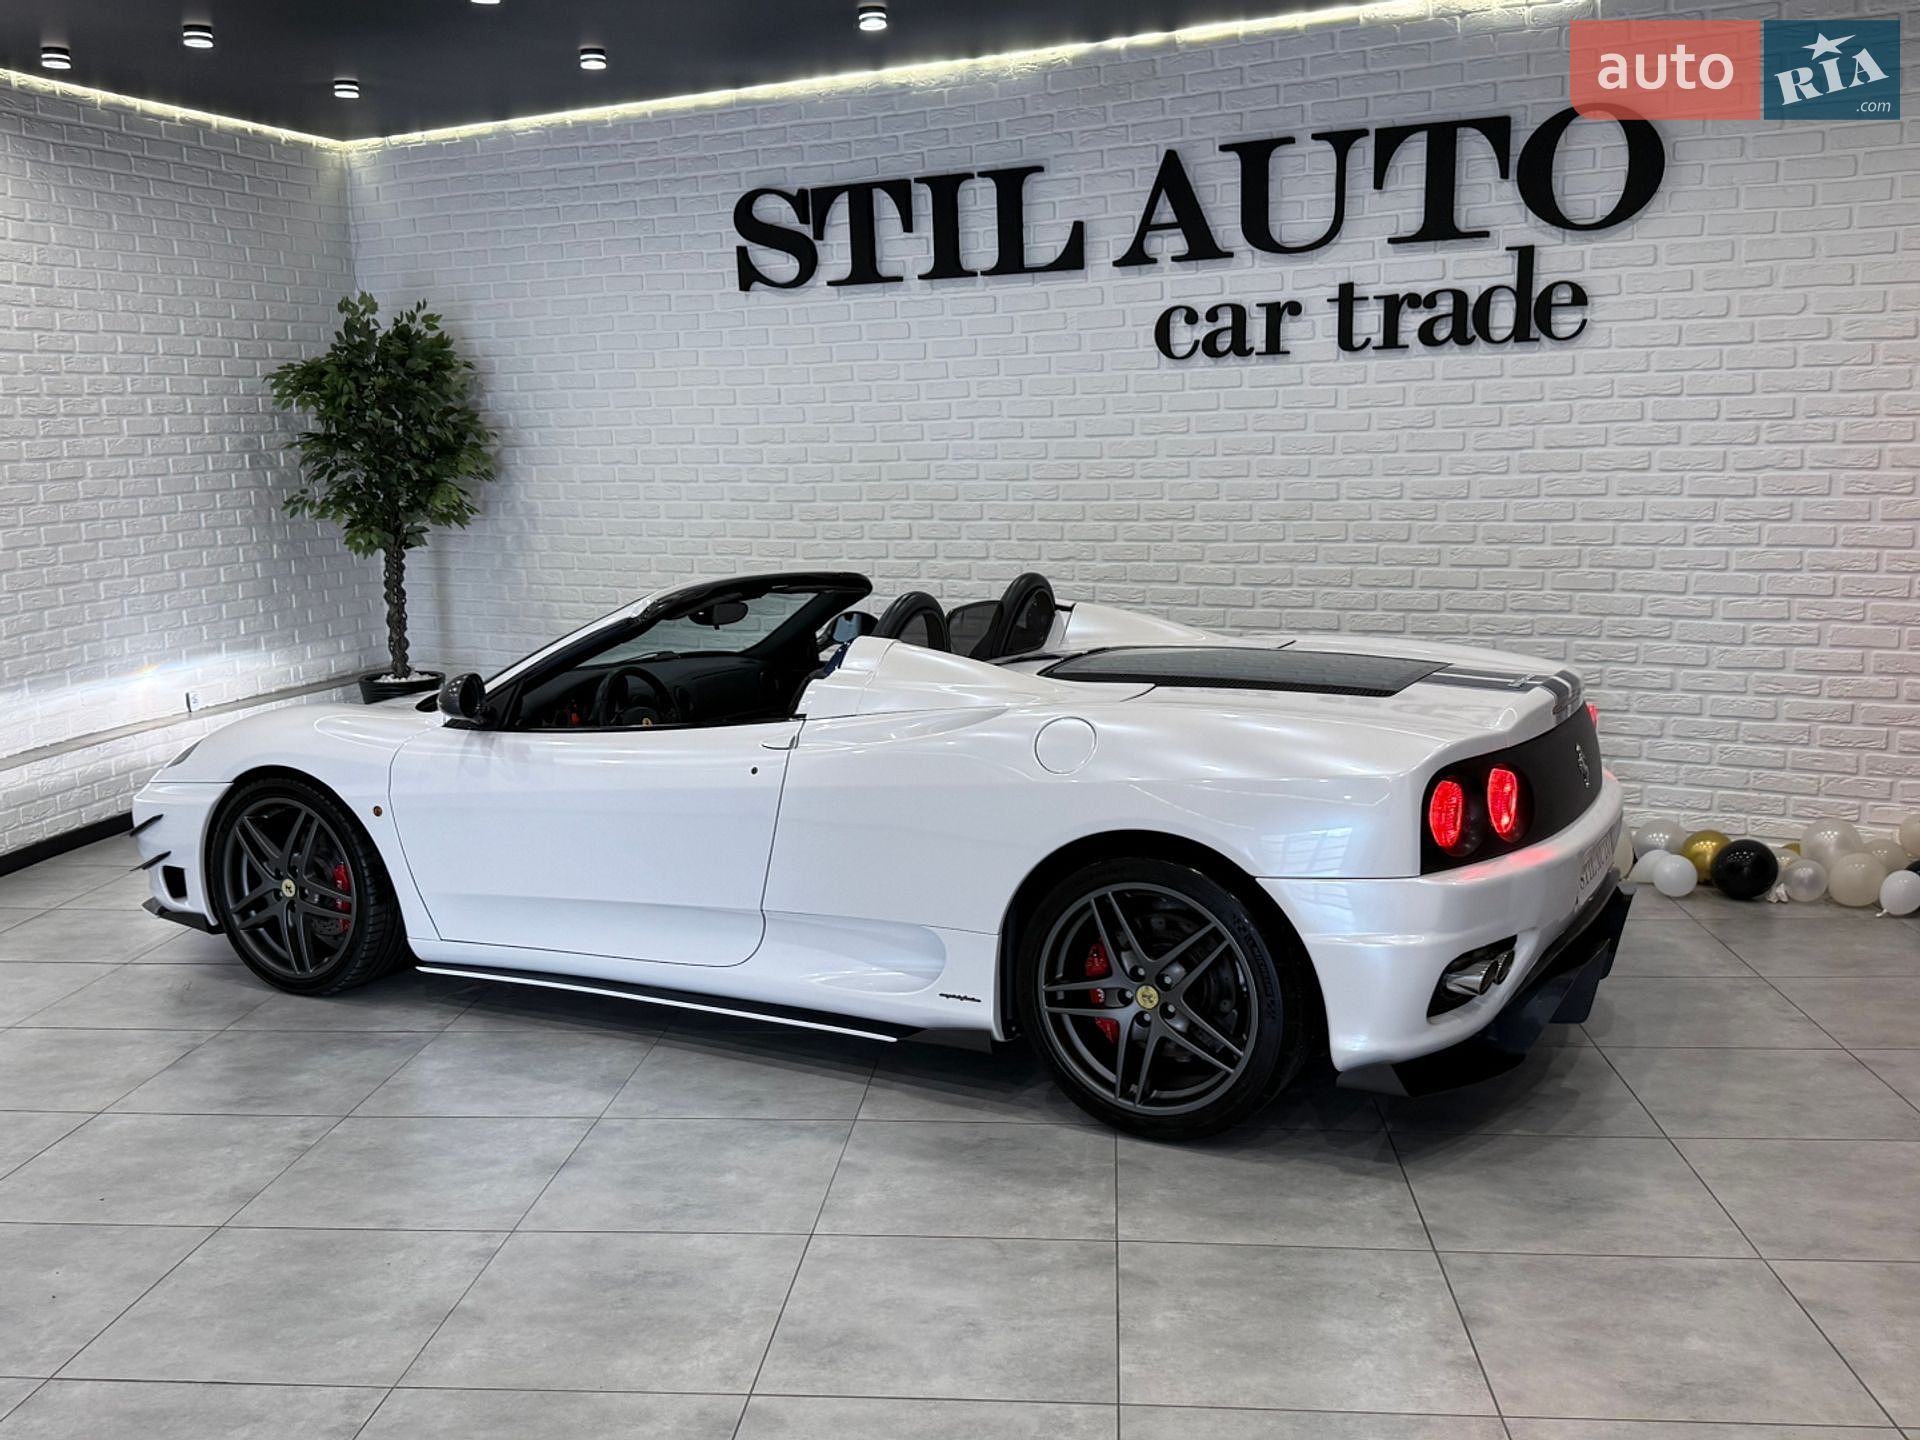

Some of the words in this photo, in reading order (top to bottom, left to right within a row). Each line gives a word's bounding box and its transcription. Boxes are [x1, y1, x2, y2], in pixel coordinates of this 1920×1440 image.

[733, 165, 1085, 292] STIL
[1112, 103, 1666, 268] AUTO
[1154, 300, 1303, 361] car
[1326, 244, 1589, 353] trade
